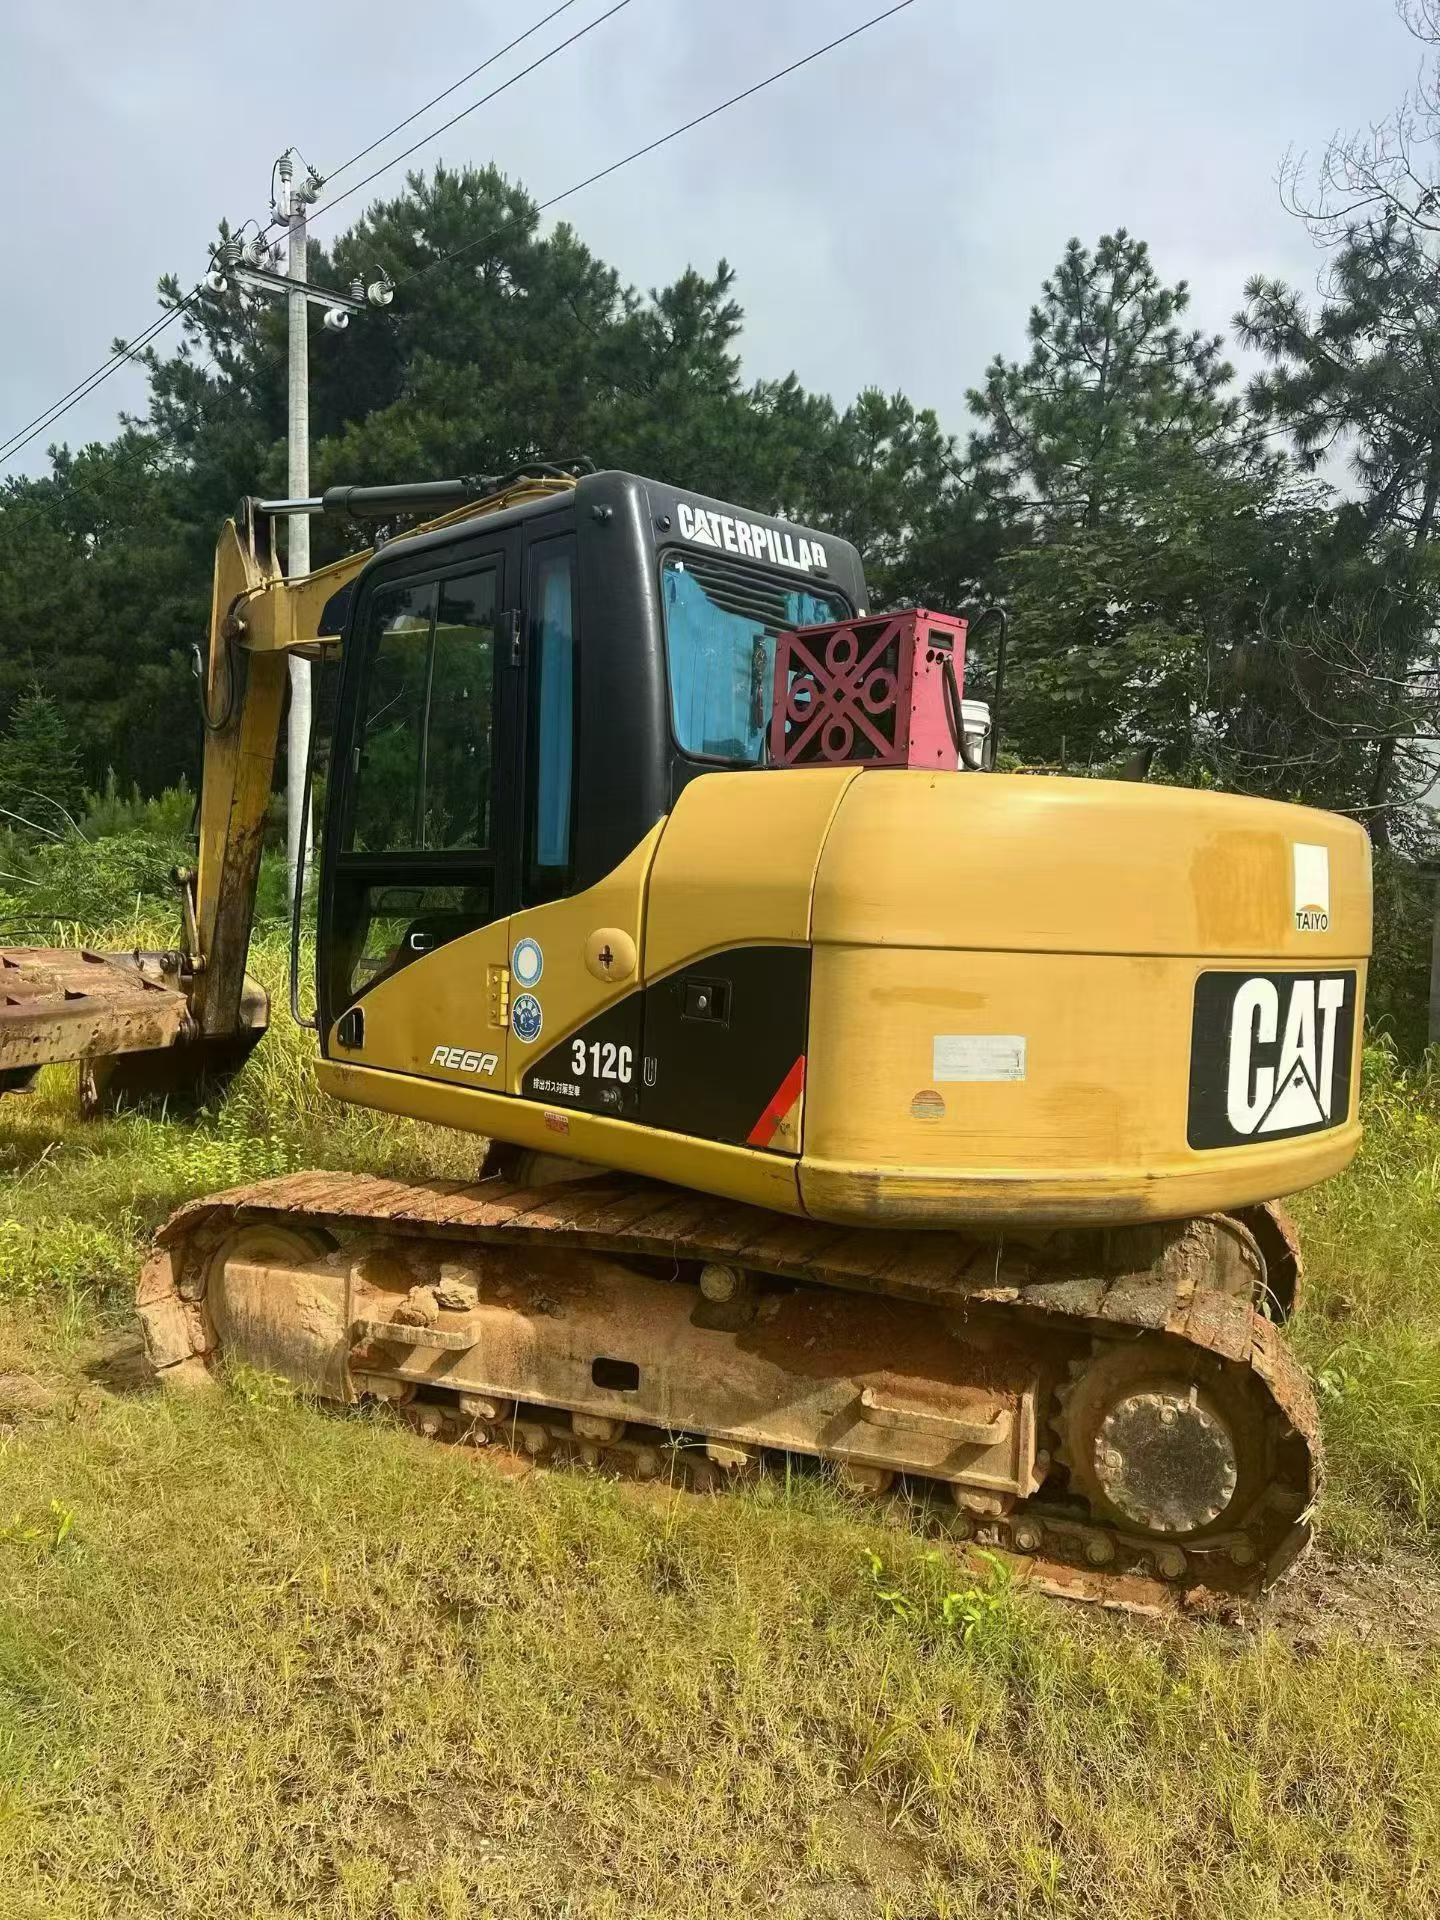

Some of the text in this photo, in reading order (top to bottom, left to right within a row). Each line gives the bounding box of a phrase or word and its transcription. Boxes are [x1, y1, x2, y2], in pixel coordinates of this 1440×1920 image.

[677, 503, 828, 572] CATERPILLAR
[1296, 912, 1328, 930] TAIYO
[429, 1045, 499, 1076] REGA
[571, 1039, 633, 1084] 312C
[1228, 978, 1345, 1135] CAT
